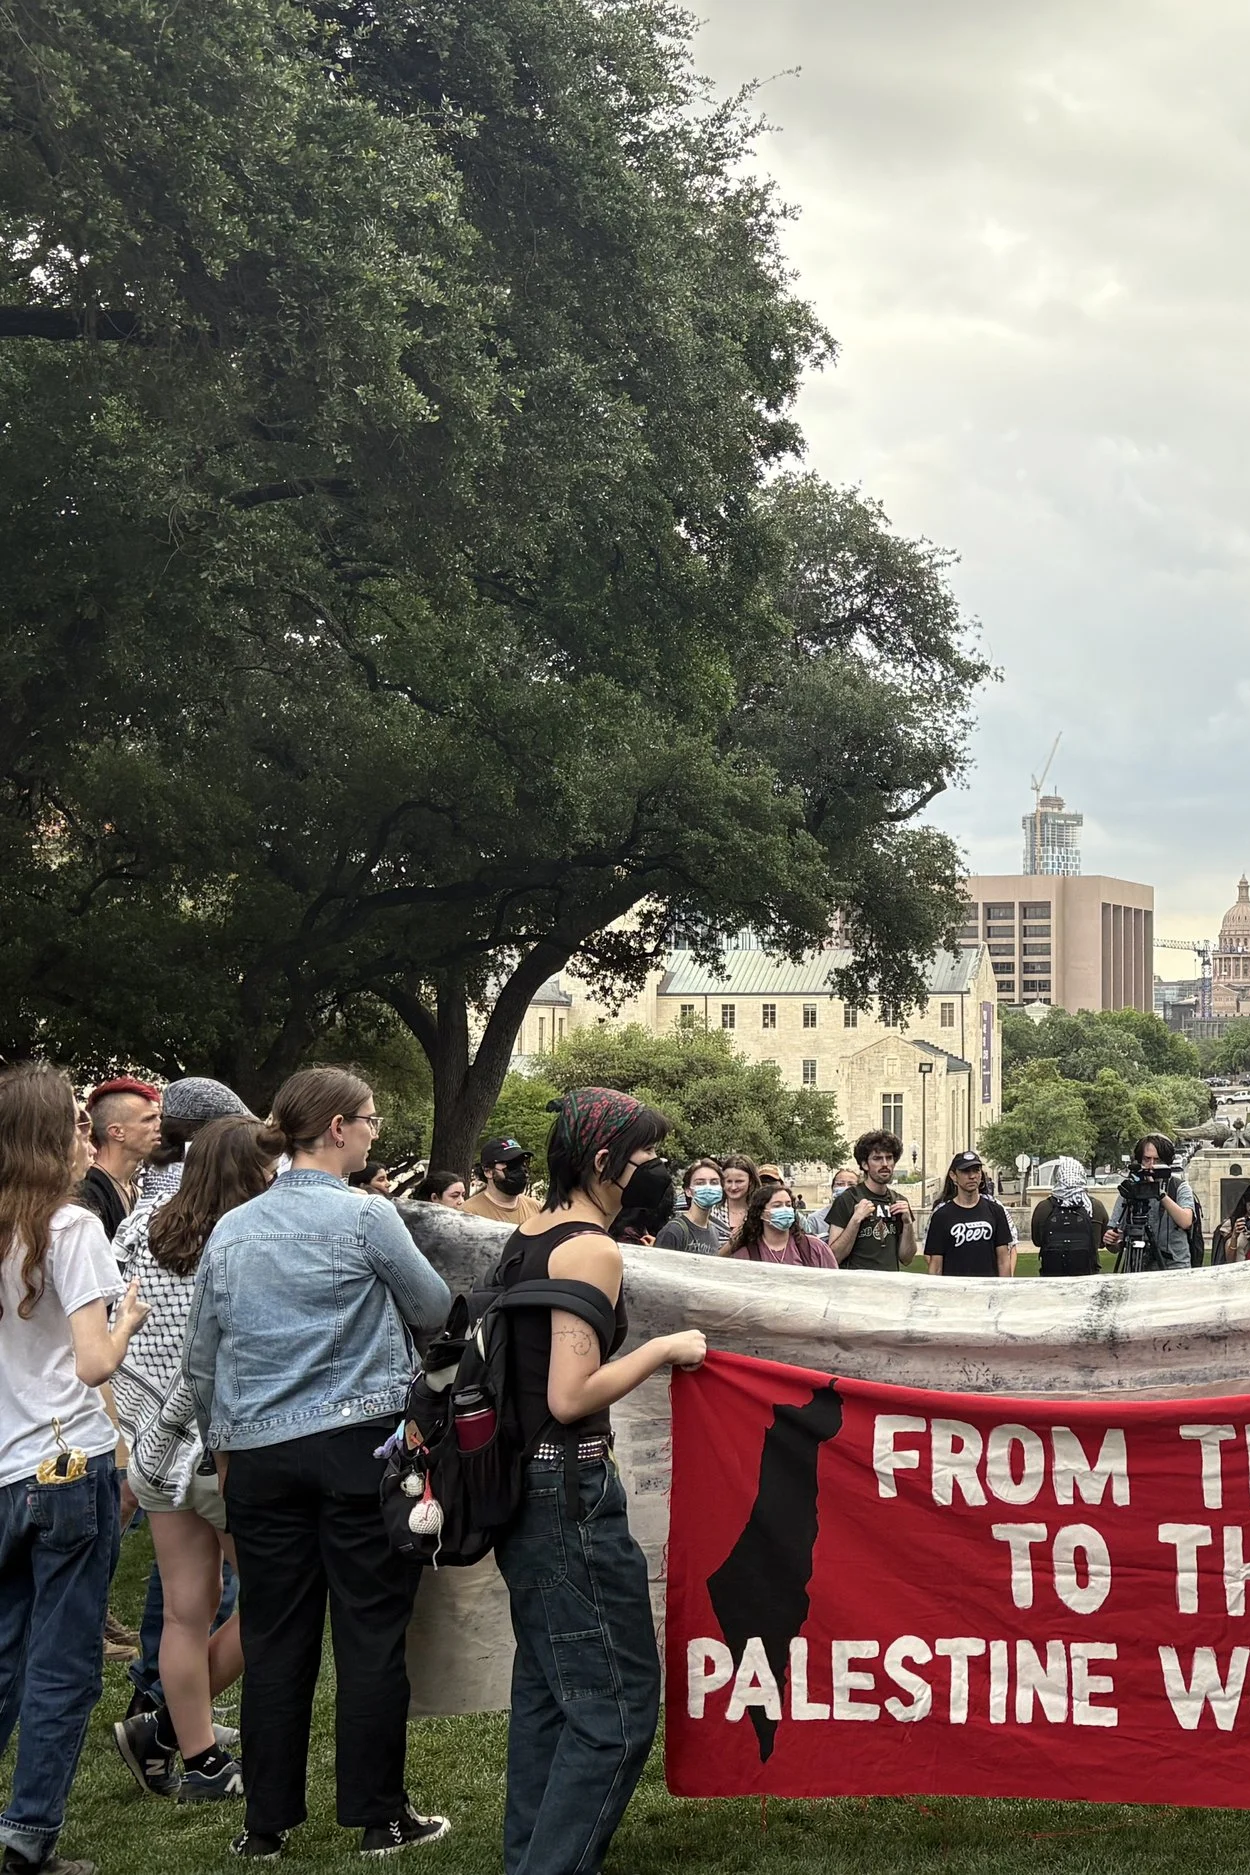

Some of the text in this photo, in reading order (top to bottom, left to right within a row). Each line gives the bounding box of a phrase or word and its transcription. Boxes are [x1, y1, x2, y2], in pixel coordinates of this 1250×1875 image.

[950, 1220, 993, 1248] Beer
[872, 1413, 1131, 1507] FROM
[990, 1522, 1113, 1615] TO
[686, 1634, 1119, 1728] PALESTINE
